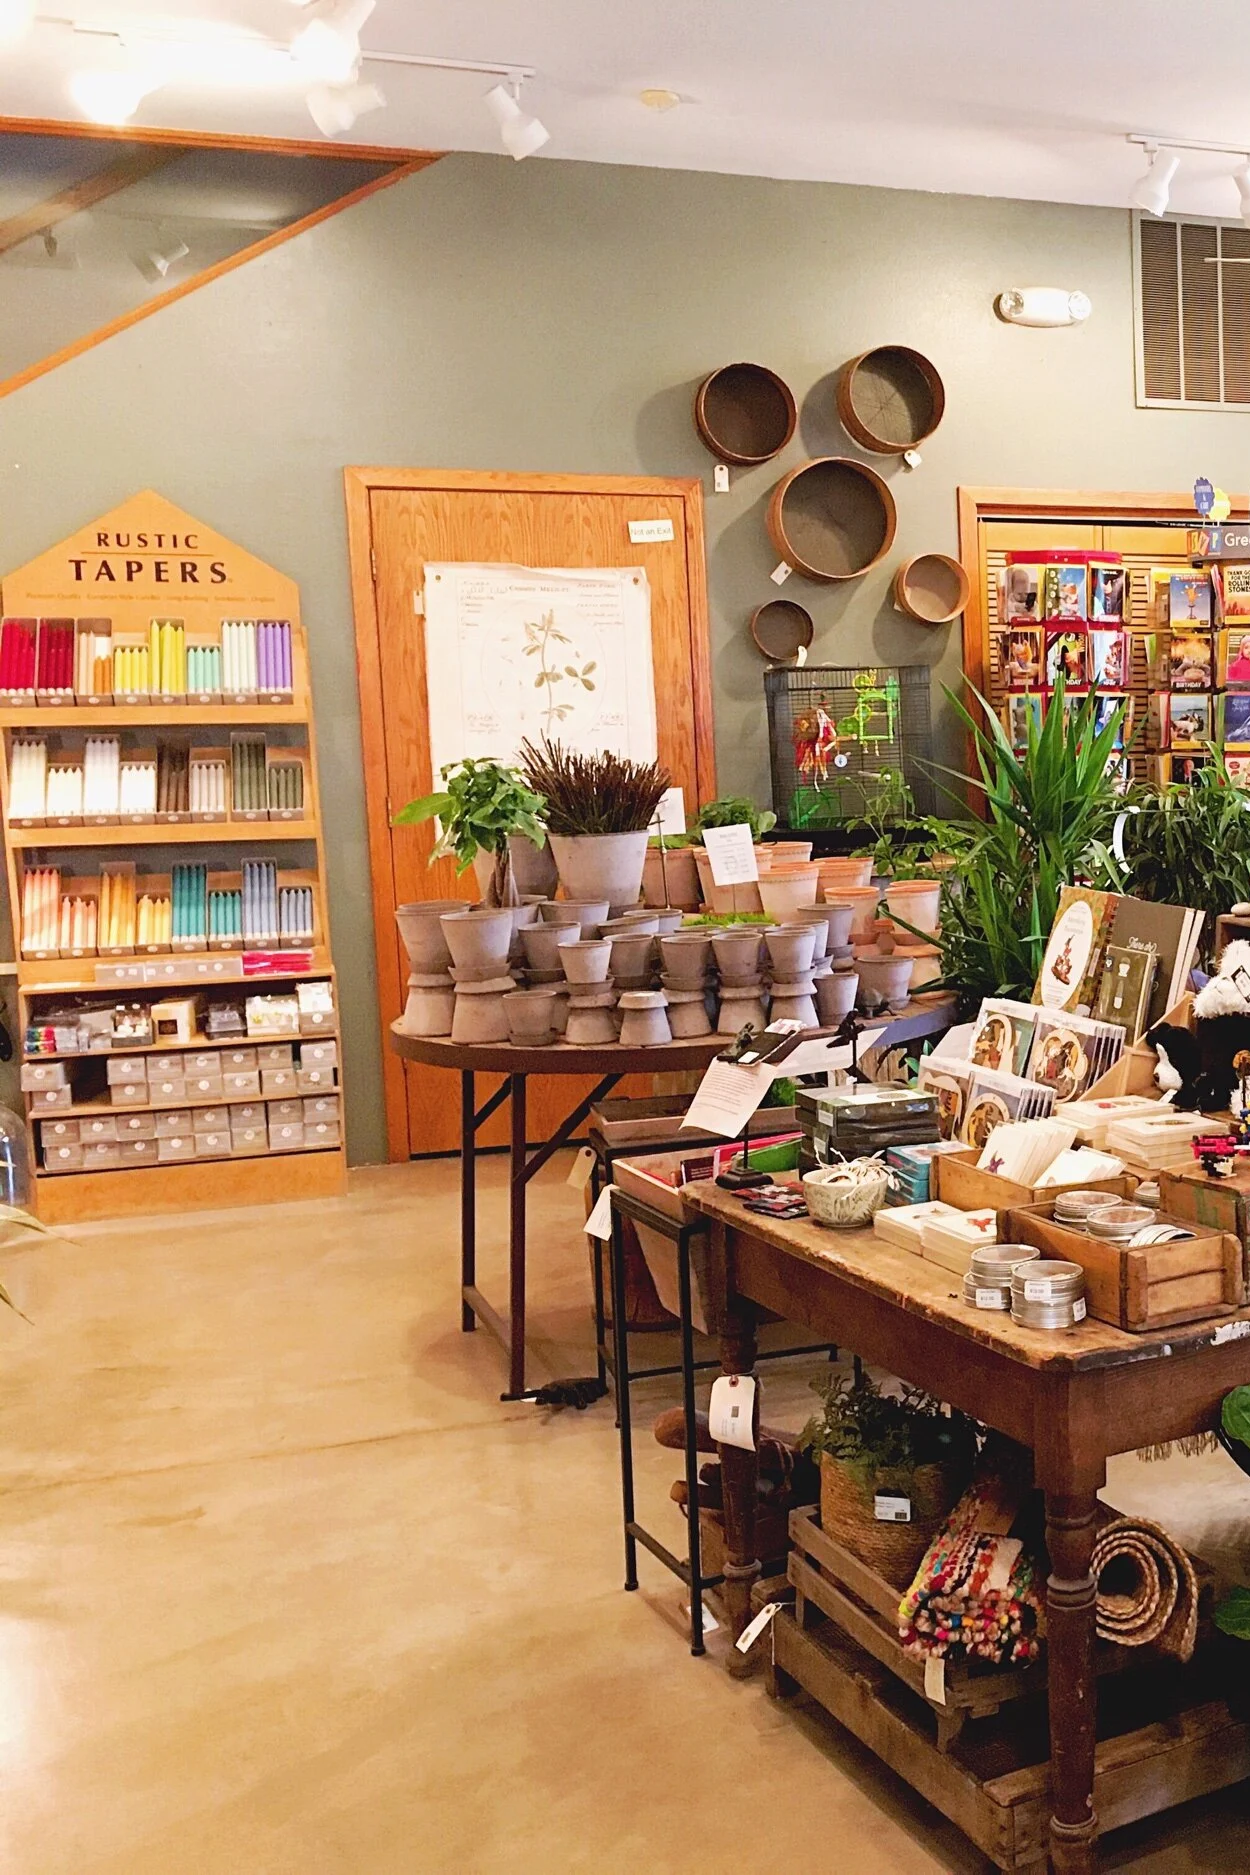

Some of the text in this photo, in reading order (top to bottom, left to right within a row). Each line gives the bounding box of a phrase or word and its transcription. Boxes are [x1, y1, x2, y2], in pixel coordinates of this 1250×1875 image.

[657, 527, 671, 535] Exit
[97, 532, 199, 550] RUSTIC
[68, 559, 227, 585] TAPERS
